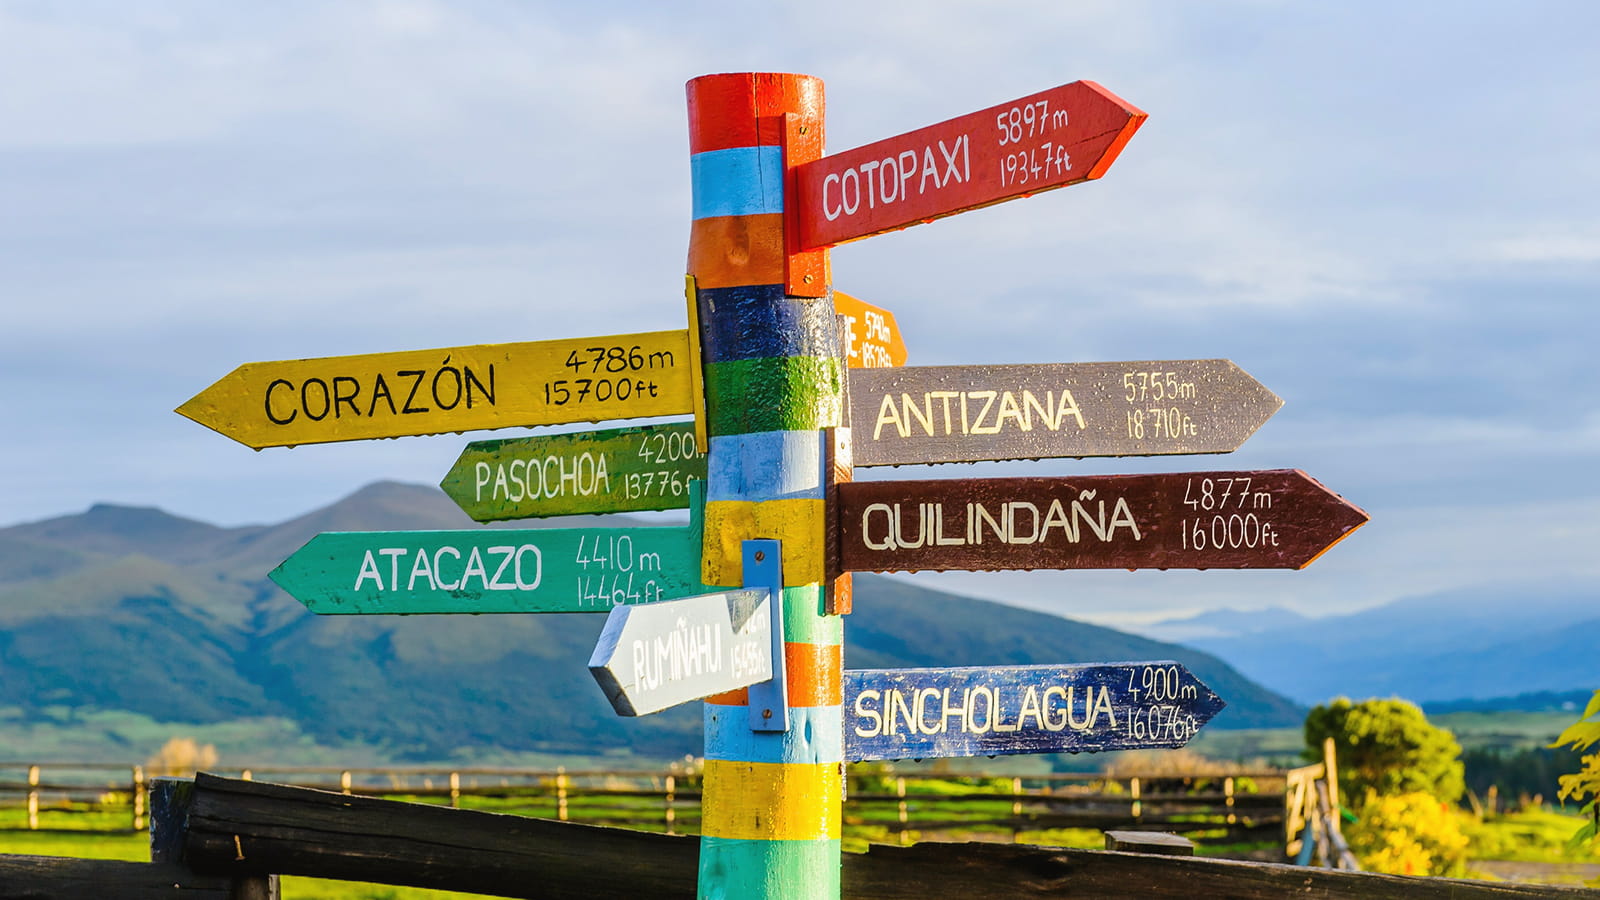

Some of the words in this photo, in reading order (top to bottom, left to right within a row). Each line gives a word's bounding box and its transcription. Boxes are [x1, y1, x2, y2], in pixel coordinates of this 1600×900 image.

[822, 134, 970, 222] COTOPAXI
[264, 355, 496, 425] CORAZÓN
[872, 389, 1086, 441] ANTIZANA
[475, 452, 610, 502] PASOCHOA
[861, 489, 1141, 552] QUILINDAÑA
[353, 544, 543, 592] ATACAZO
[854, 685, 1118, 738] SINCHOLAGUA
